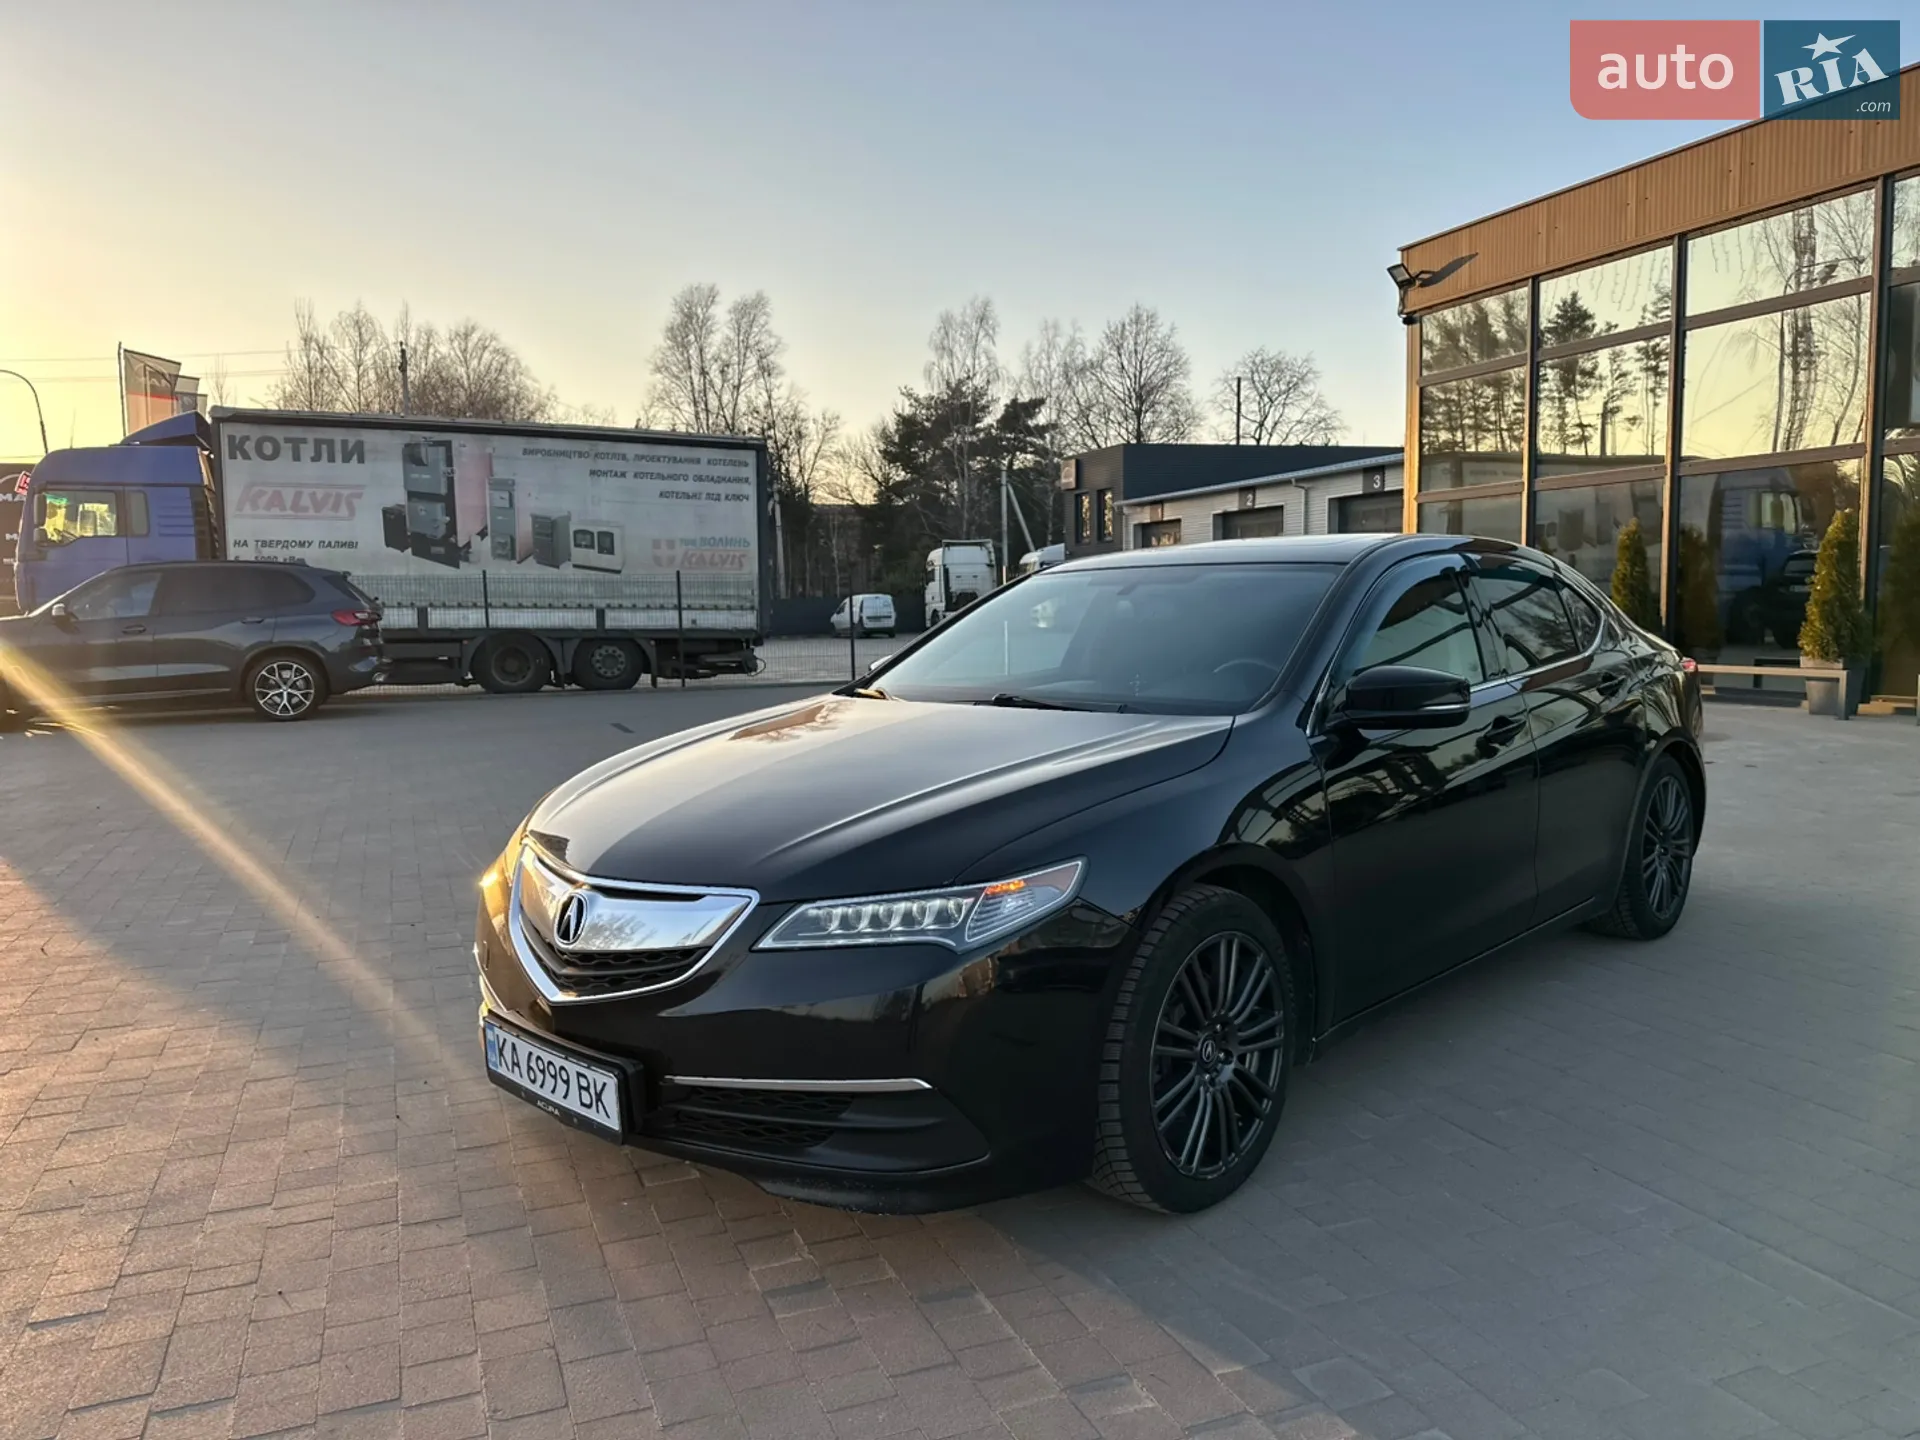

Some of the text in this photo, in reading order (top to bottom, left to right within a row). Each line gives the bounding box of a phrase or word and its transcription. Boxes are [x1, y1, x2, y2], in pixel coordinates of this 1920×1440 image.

[227, 434, 365, 464] КОТЛИ
[522, 447, 590, 459] ВИРОБНИЦТВО
[589, 469, 627, 478] МОНТАЖ
[633, 472, 689, 481] КОТЕЛЬНОГО
[1373, 474, 1381, 489] 3
[235, 484, 365, 520] KALVIS
[725, 493, 750, 502] КЛЮЧ
[1246, 493, 1254, 506] 2
[233, 540, 359, 549] НА ТВЕРДОМУ ПАЛИВІ
[496, 1034, 610, 1119] KA 6999 BK
[537, 1100, 560, 1116] ACURA
